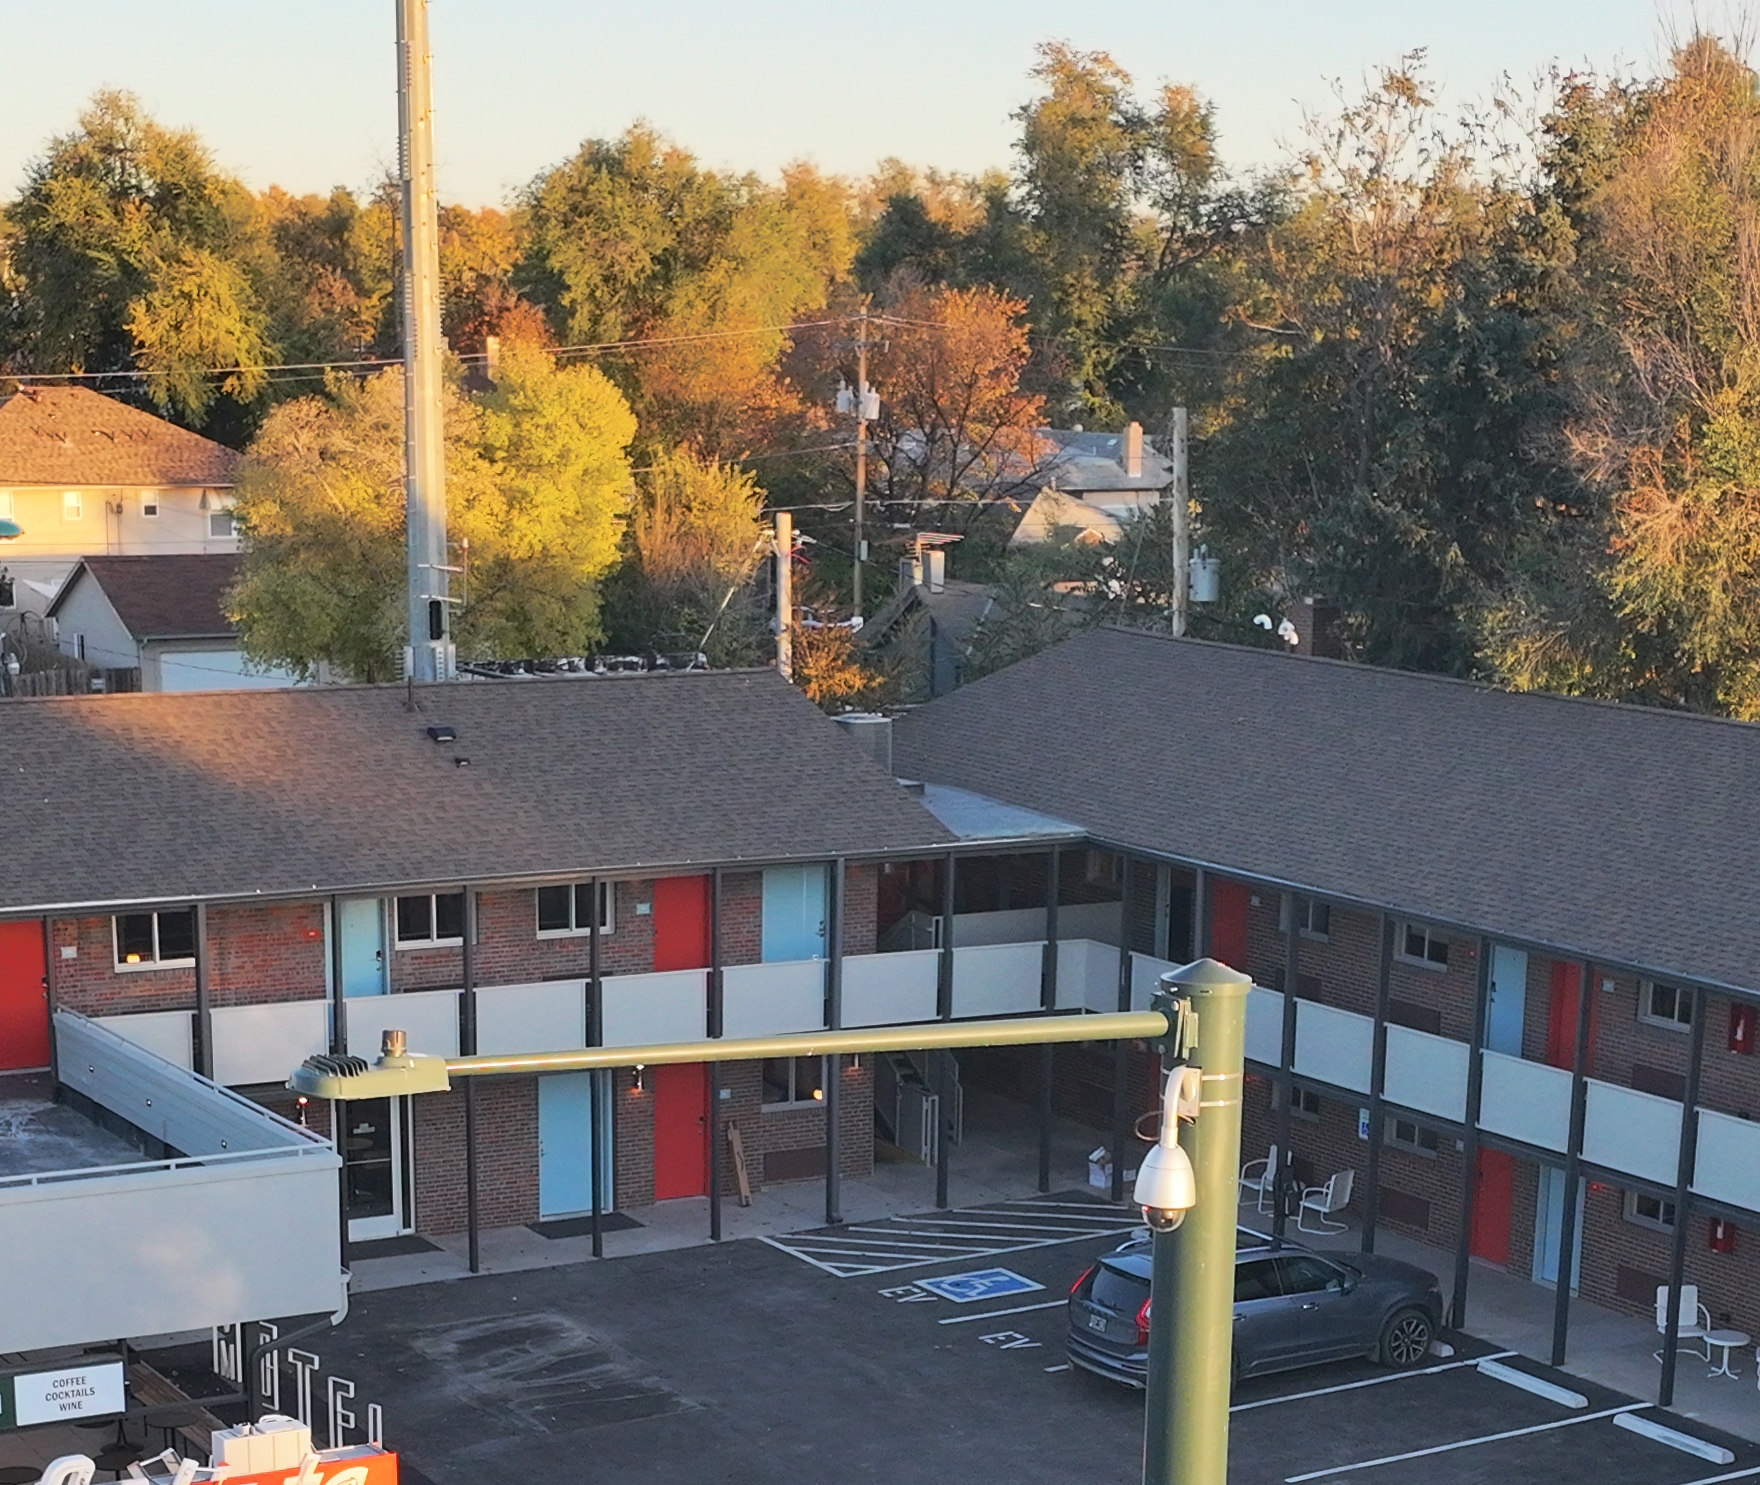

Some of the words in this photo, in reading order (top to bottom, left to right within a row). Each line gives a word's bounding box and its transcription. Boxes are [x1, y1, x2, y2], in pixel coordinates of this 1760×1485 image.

[878, 1286, 938, 1303] EV
[978, 1331, 1042, 1349] EV
[53, 1376, 87, 1389] COFFEE
[45, 1387, 96, 1402] COCKTAILS
[59, 1401, 83, 1412] WINE
